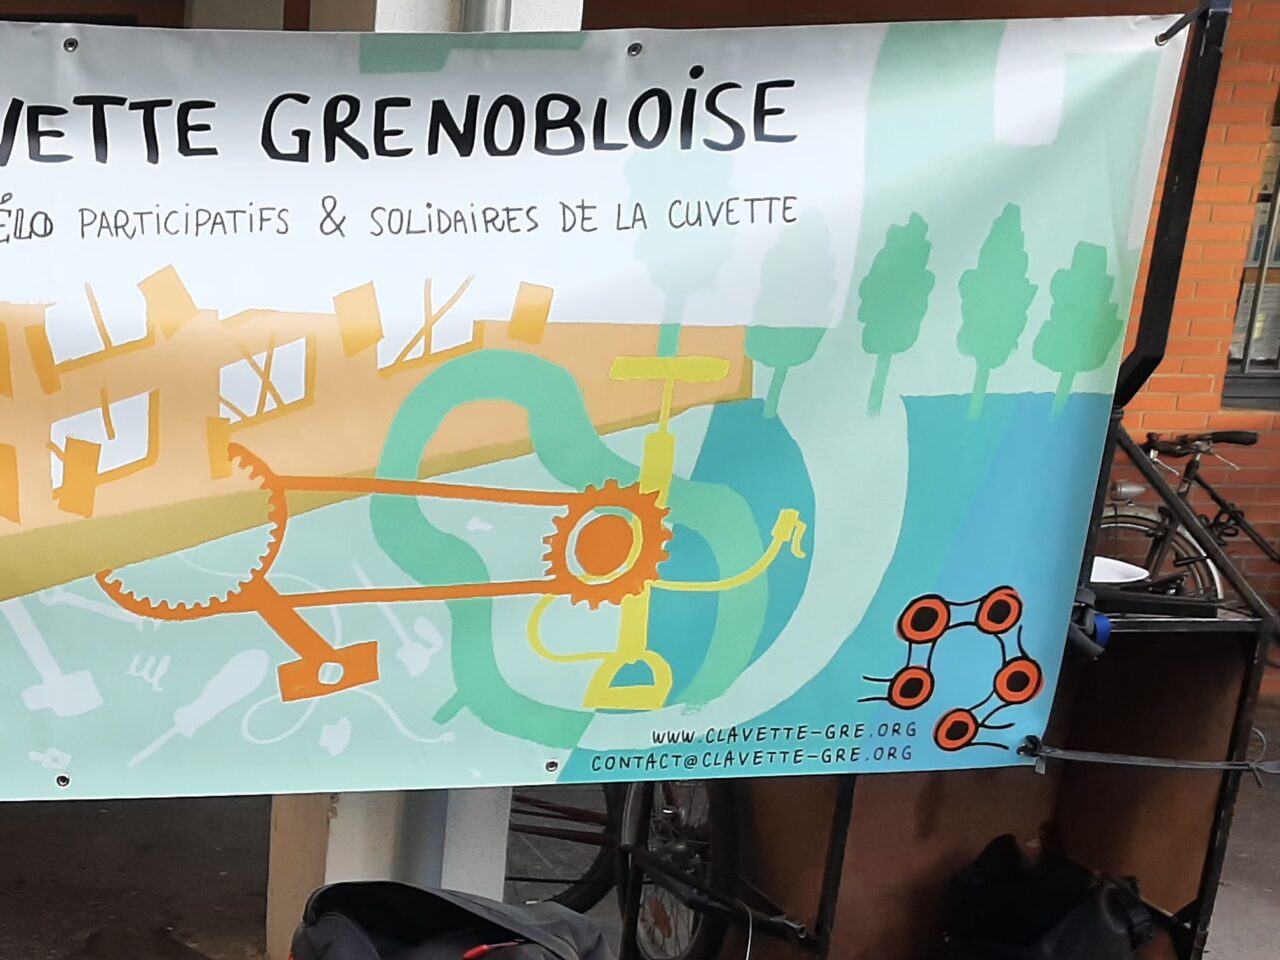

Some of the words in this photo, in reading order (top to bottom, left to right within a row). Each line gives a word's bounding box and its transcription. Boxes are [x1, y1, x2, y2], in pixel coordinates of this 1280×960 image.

[319, 195, 347, 238] &
[559, 199, 598, 234] DE
[616, 201, 648, 231] LA
[668, 195, 798, 230] CUVETTE
[652, 722, 918, 745] WWW.CLAVETTE-GRE.ORG
[591, 745, 913, 772] CONTACT@CLAVETTE-GRE.ORG
